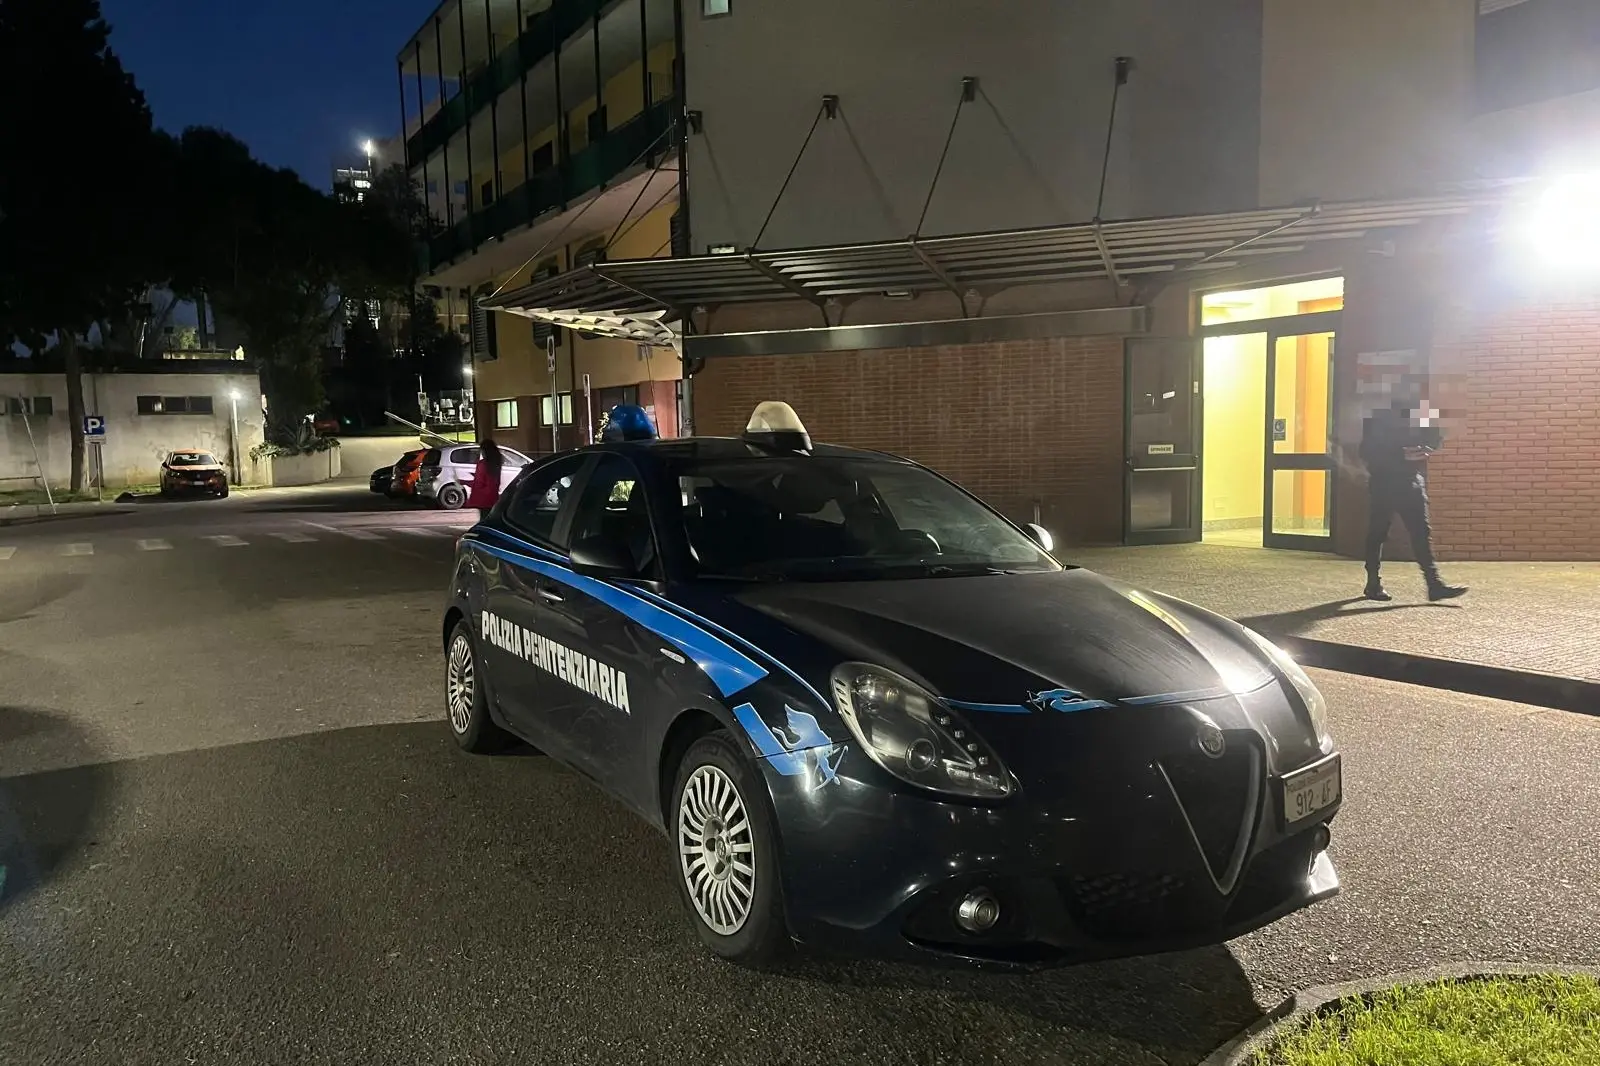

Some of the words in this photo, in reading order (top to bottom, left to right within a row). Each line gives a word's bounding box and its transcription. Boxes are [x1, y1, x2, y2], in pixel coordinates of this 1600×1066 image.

[88, 418, 100, 433] P
[482, 610, 523, 659] POLIZIA
[523, 628, 630, 715] PENITENZIARIA
[1296, 789, 1315, 816] 912
